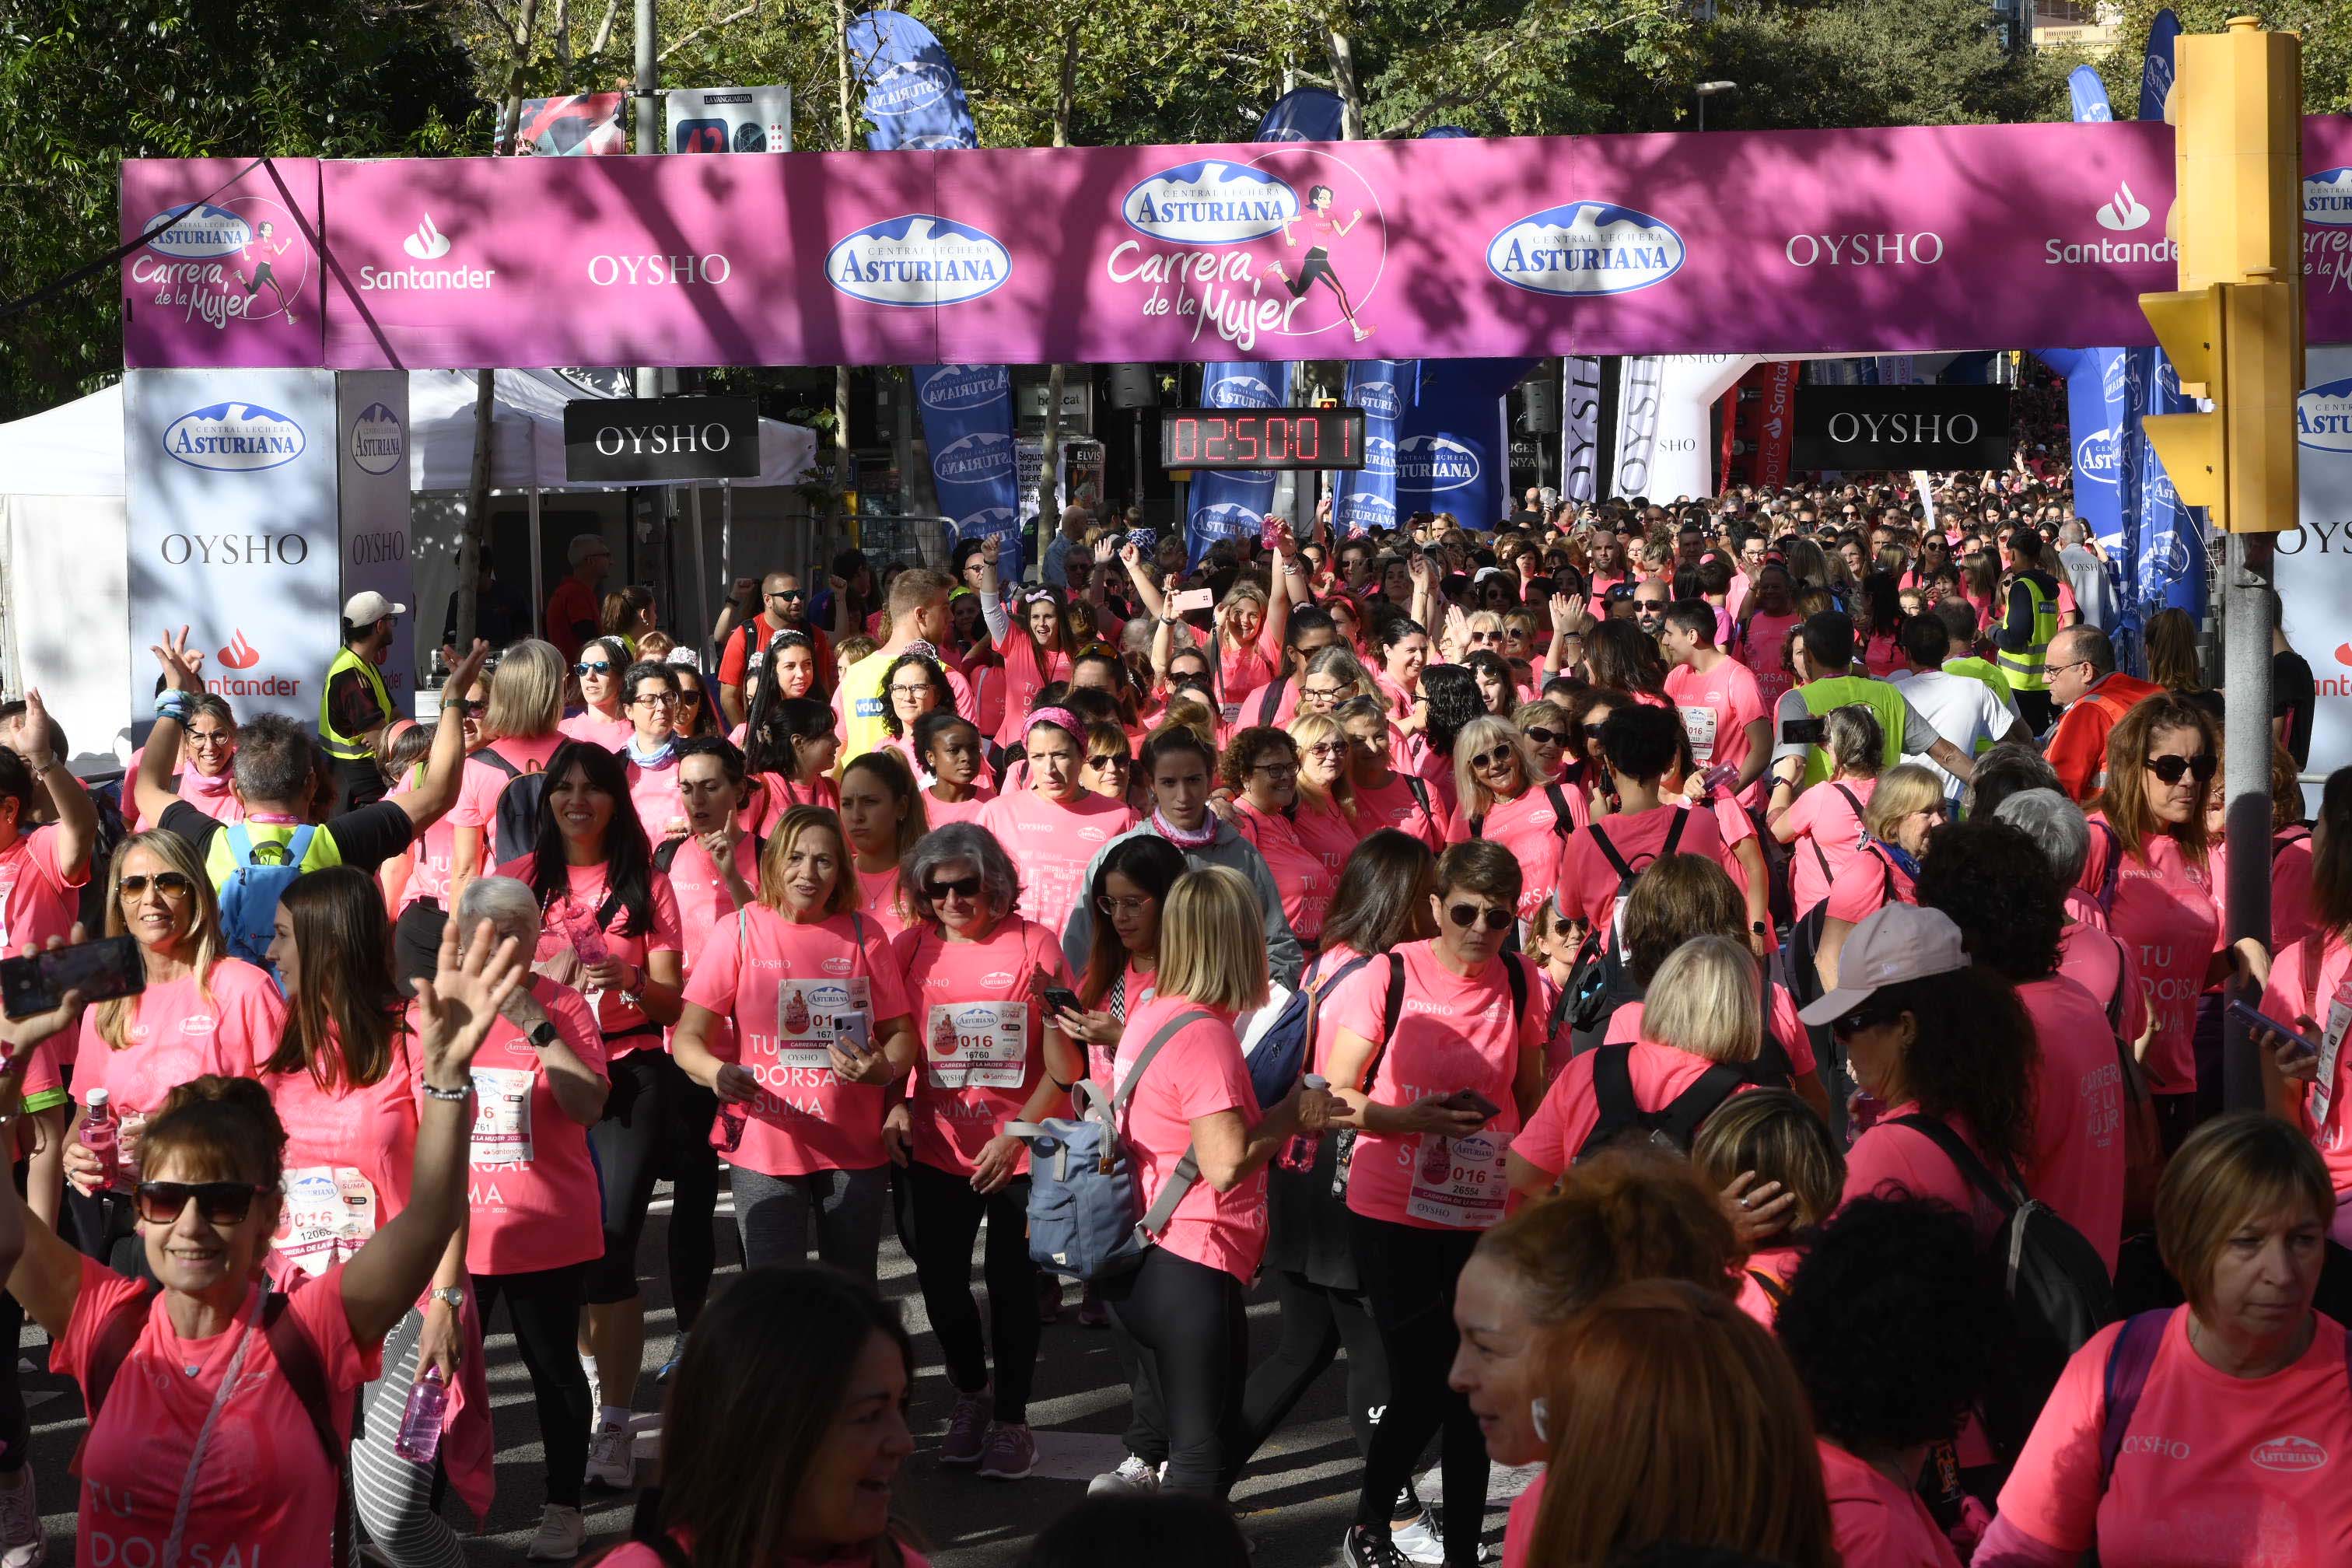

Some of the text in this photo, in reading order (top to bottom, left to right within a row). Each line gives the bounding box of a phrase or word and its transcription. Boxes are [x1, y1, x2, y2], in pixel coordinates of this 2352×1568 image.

[714, 94, 752, 103] VANGUARDIA
[1136, 192, 1284, 223] ASTURIANA
[150, 223, 243, 244] ASTURIANA
[1532, 233, 1663, 244] CENTRAL LECHERA
[1502, 239, 1669, 273] ASTURIANA
[1786, 232, 1944, 266] OYSHO
[132, 254, 223, 284] Carrera
[587, 254, 731, 286] OYSHO
[838, 250, 997, 283] ASTURIANA
[1107, 240, 1252, 284] Carrera
[359, 264, 495, 291] Santander
[155, 282, 258, 329] de la Mujer
[1143, 277, 1307, 352] de la Mujer
[1828, 412, 1979, 444] OYSHO
[173, 428, 296, 454] ASTURIANA
[355, 433, 401, 457] ASTURIANA
[595, 422, 730, 456] OYSHO
[1076, 450, 1101, 461] ELVIS
[1019, 472, 1043, 482] quiere
[1020, 493, 1034, 502] este
[160, 534, 309, 565] OYSHO
[352, 530, 404, 565] OYSHO
[1017, 822, 1053, 833] OYSHO
[430, 856, 450, 872] TU
[1322, 852, 1341, 867] TU
[1300, 875, 1317, 891] TU
[2122, 870, 2164, 879] OYSHO
[751, 958, 791, 969] OYSHO
[2140, 945, 2172, 968] TU
[811, 993, 848, 1003] ASTURIANA
[1406, 999, 1453, 1016] OYSHO
[959, 1015, 995, 1024] ASTURIANA
[749, 1034, 778, 1056] TU
[961, 1035, 993, 1048] 016
[754, 1094, 824, 1116] SUMA
[491, 1147, 527, 1156] Santander
[1452, 1167, 1487, 1184] 016
[1452, 1185, 1479, 1196] 26554
[295, 1211, 333, 1227] 016
[1417, 1204, 1450, 1217] OYSHO
[2256, 1449, 2321, 1464] ASTURIANA
[86, 1478, 133, 1518] TU
